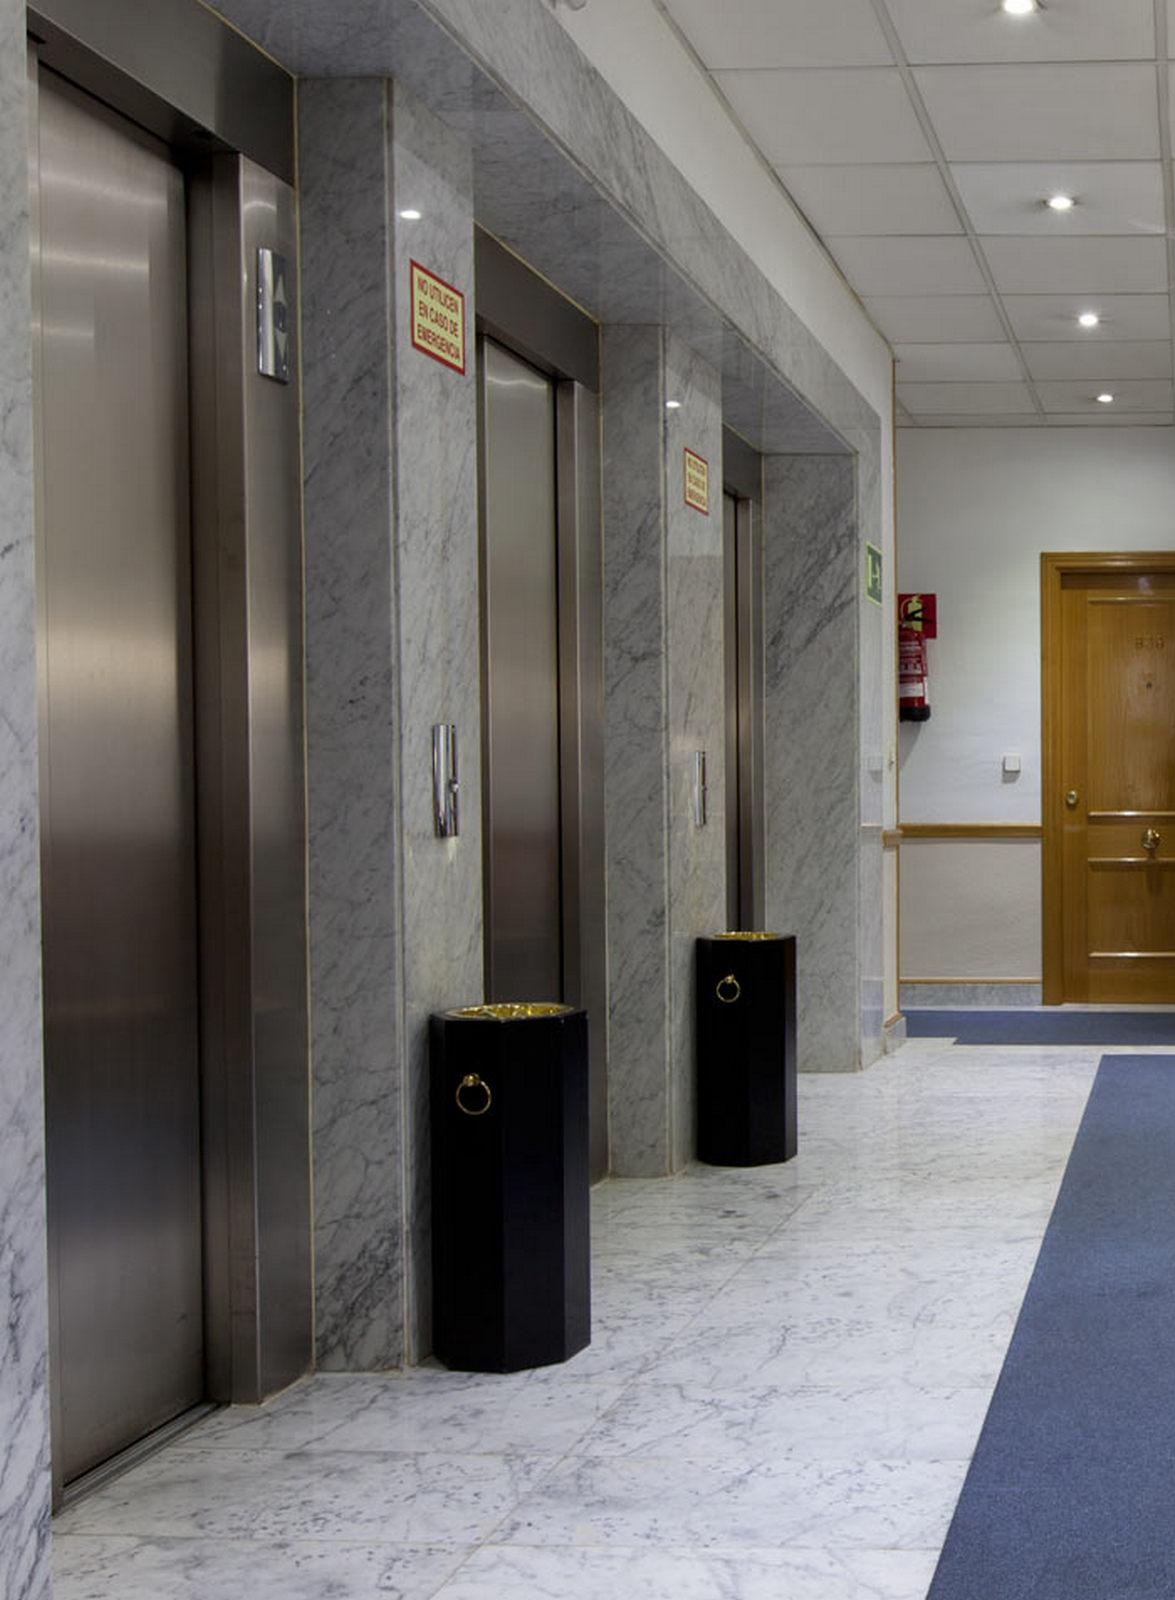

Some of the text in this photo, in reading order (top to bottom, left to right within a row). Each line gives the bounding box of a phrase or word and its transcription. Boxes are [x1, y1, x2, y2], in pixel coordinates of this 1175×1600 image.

[417, 275, 428, 296] NO
[419, 299, 459, 338] EN CASO DE
[417, 323, 460, 359] EMERGENCIA
